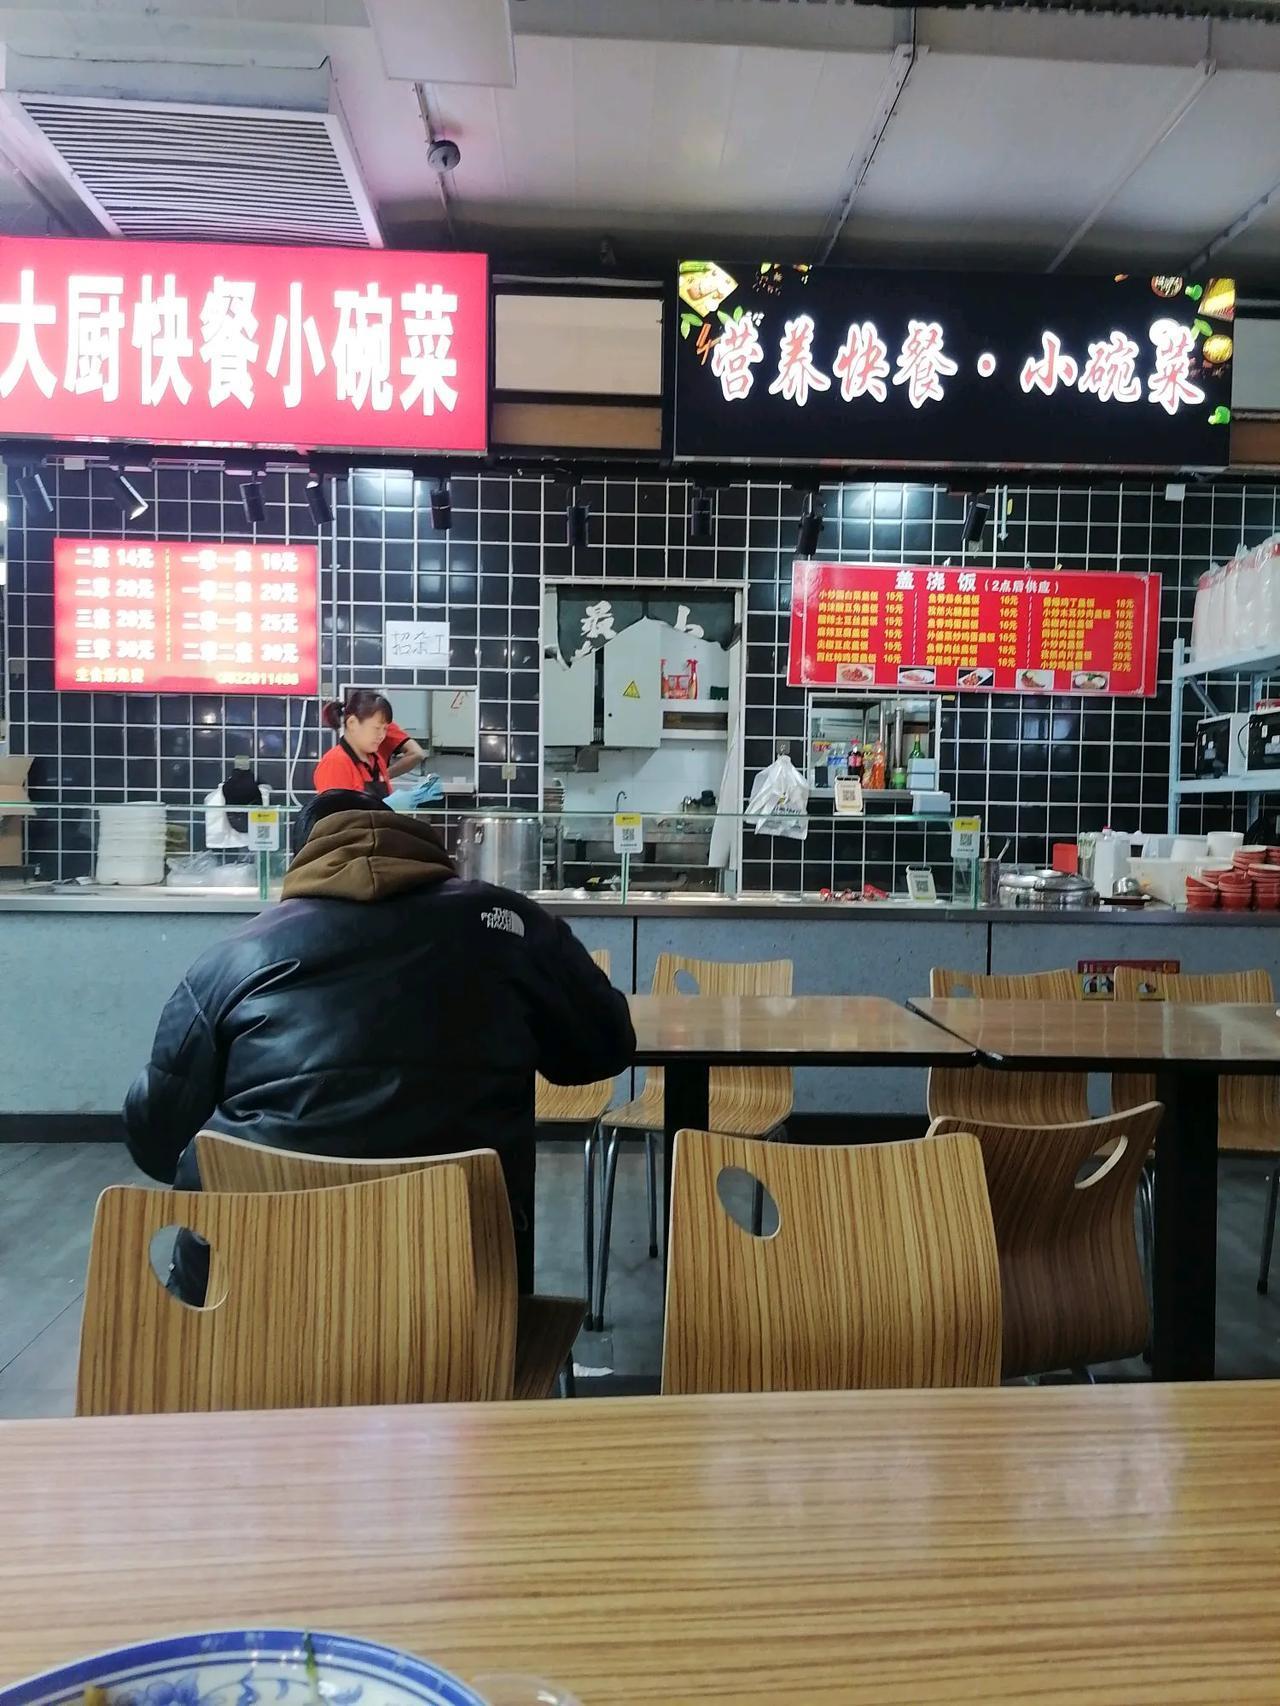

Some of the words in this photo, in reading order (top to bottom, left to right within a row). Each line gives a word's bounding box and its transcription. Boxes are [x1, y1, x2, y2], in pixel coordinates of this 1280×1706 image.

[0, 269, 458, 416] 大厨快餐小碗菜
[117, 548, 155, 569] 14元
[895, 570, 976, 592] 盖浇饭
